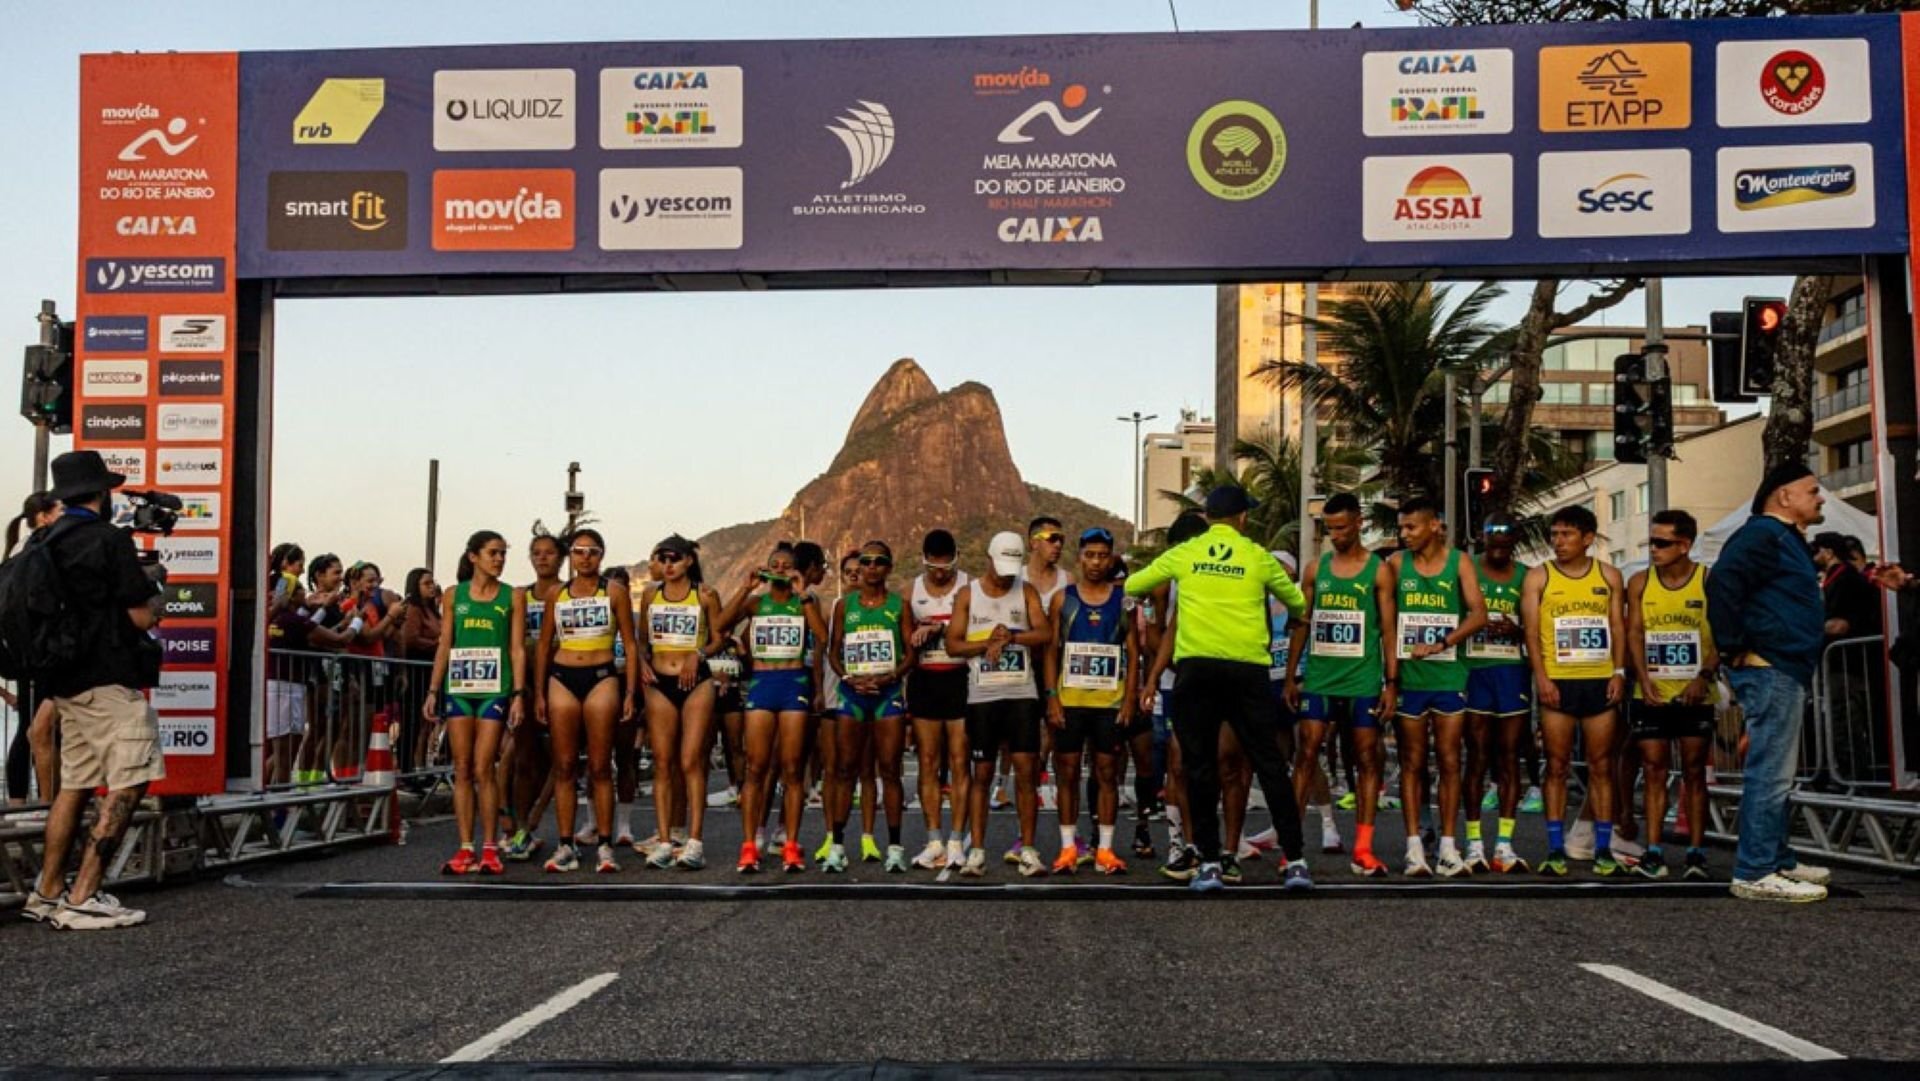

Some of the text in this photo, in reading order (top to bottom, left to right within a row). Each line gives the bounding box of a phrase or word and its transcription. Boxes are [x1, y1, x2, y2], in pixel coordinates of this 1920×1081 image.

[1398, 54, 1476, 74] CAIXA
[634, 71, 708, 90] CAIXA
[974, 65, 1050, 88] movida
[1764, 87, 1777, 97] 3
[101, 103, 160, 120] movida
[473, 99, 563, 120] LIQUIDZ
[1391, 96, 1485, 121] BRASIL
[1567, 100, 1663, 126] ETAPP
[299, 123, 333, 138] rvb
[626, 111, 716, 134] BRASIL
[983, 152, 1117, 169] MEIA MARATONA
[106, 168, 208, 180] MEIA MARATONA
[100, 187, 215, 199] DO RIO DE JANEIRO
[975, 177, 1126, 194] DO RIO DE JANEIRO
[285, 190, 386, 220] smart fit
[445, 187, 562, 224] movida
[644, 196, 732, 217] yescom
[812, 193, 907, 203] ATLETISMO
[1578, 188, 1653, 213] Sesc
[792, 204, 926, 215] SUDAMERICANO
[116, 215, 198, 236] CAIXA
[997, 216, 1104, 242] CAIXA
[1406, 222, 1471, 231] ATACADISTA
[129, 263, 214, 284] yescom
[86, 416, 142, 430] cinépolis
[1192, 562, 1245, 576] yescom
[166, 603, 204, 613] COPRA
[1321, 593, 1358, 609] BRASIL
[1405, 592, 1448, 608] BRASIL
[1484, 598, 1516, 613] RASIL
[463, 618, 495, 630] BRASIL
[575, 607, 608, 627] 154
[666, 614, 696, 634] 152
[769, 627, 800, 645] 158
[1332, 624, 1354, 642] 60
[1579, 628, 1602, 648] 55
[168, 640, 210, 651] POISE
[859, 641, 892, 661] 155
[1665, 644, 1691, 665] 56
[463, 661, 497, 679] 157
[1088, 657, 1109, 676] 51
[173, 730, 209, 748] RIO
